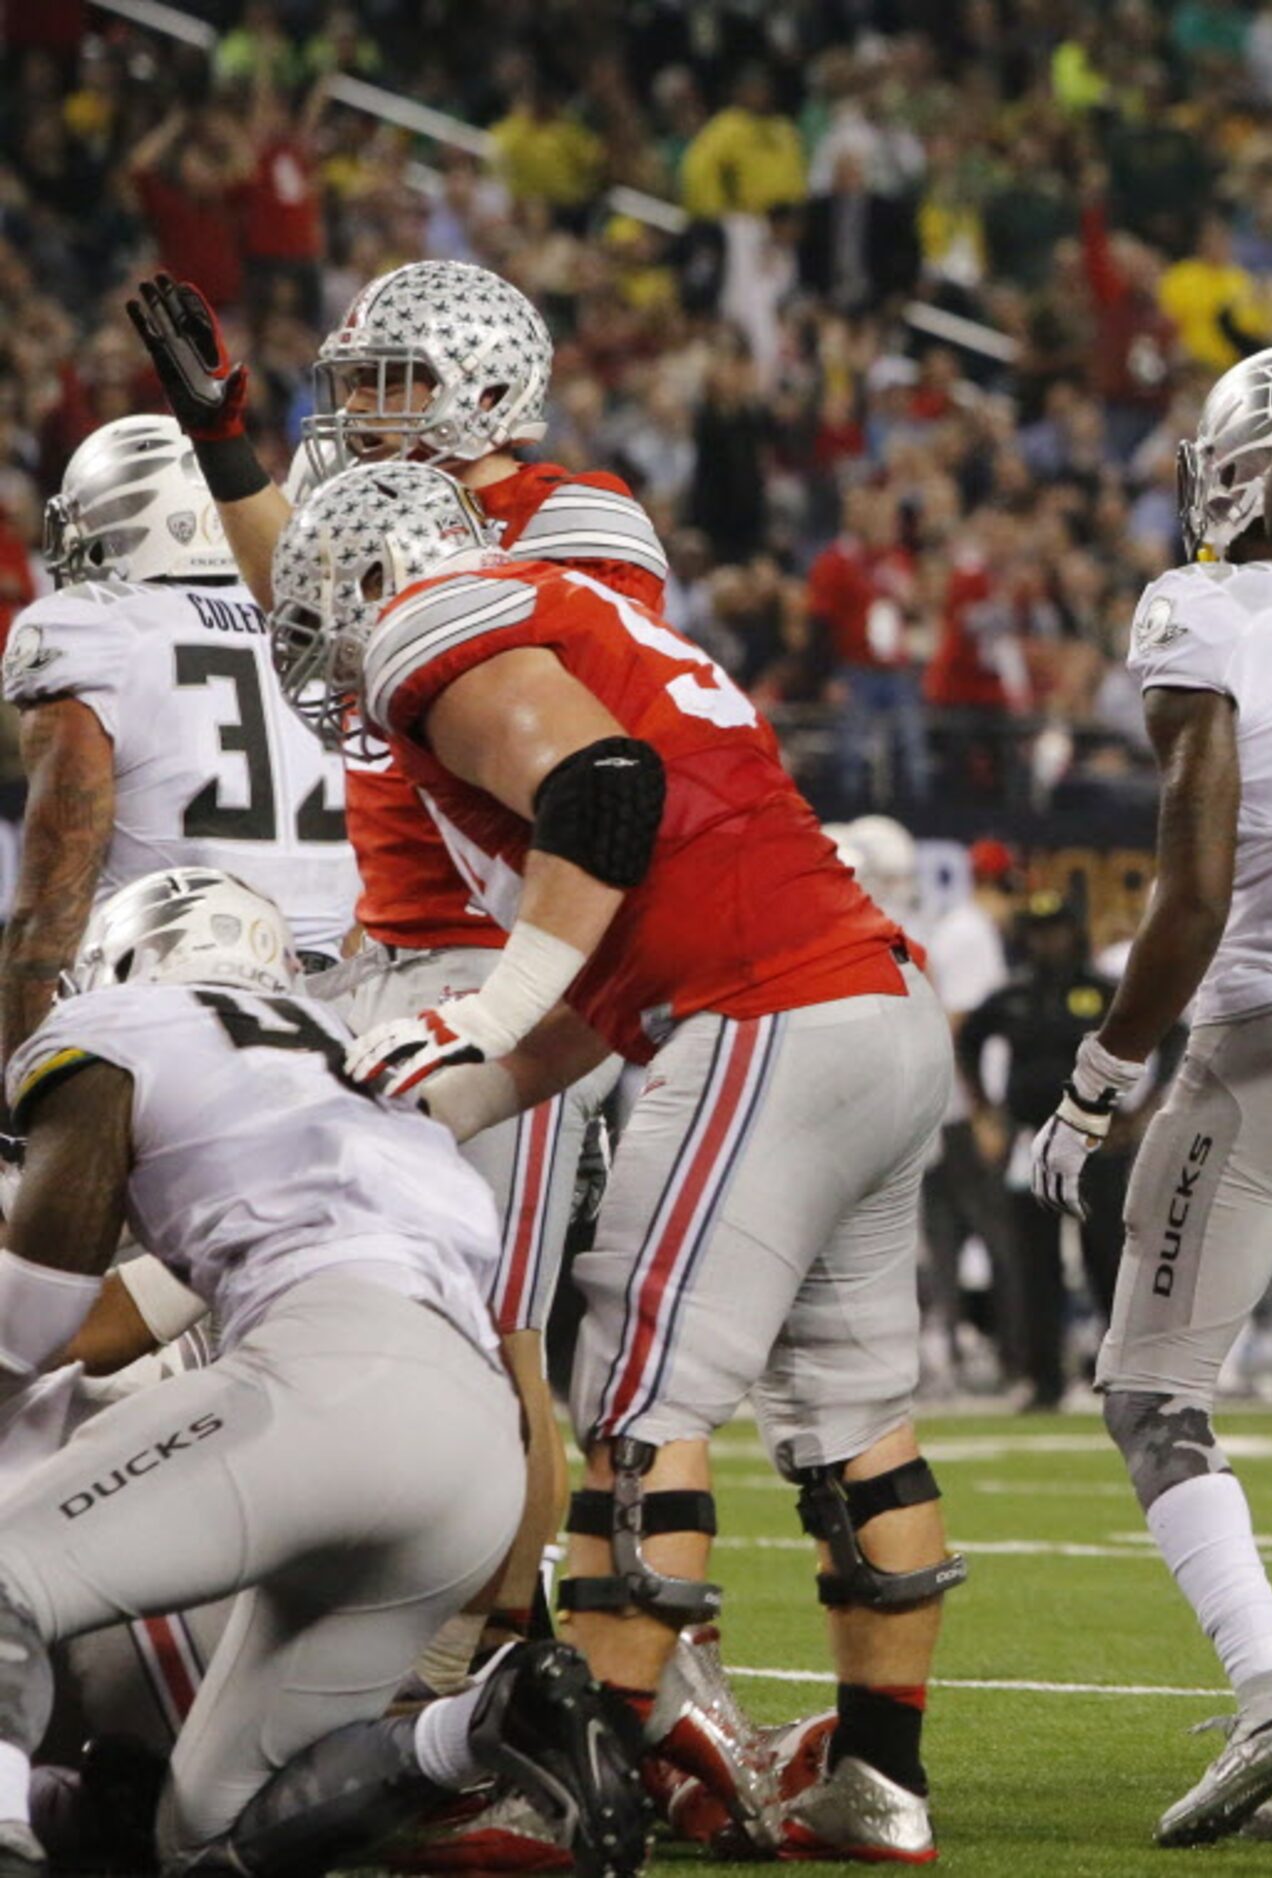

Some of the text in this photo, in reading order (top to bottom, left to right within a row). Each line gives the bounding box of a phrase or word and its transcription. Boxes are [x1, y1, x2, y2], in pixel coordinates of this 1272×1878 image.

[173, 643, 348, 841] 3
[1152, 1133, 1213, 1298] DUCKS
[58, 1412, 224, 1520] DUCKS
